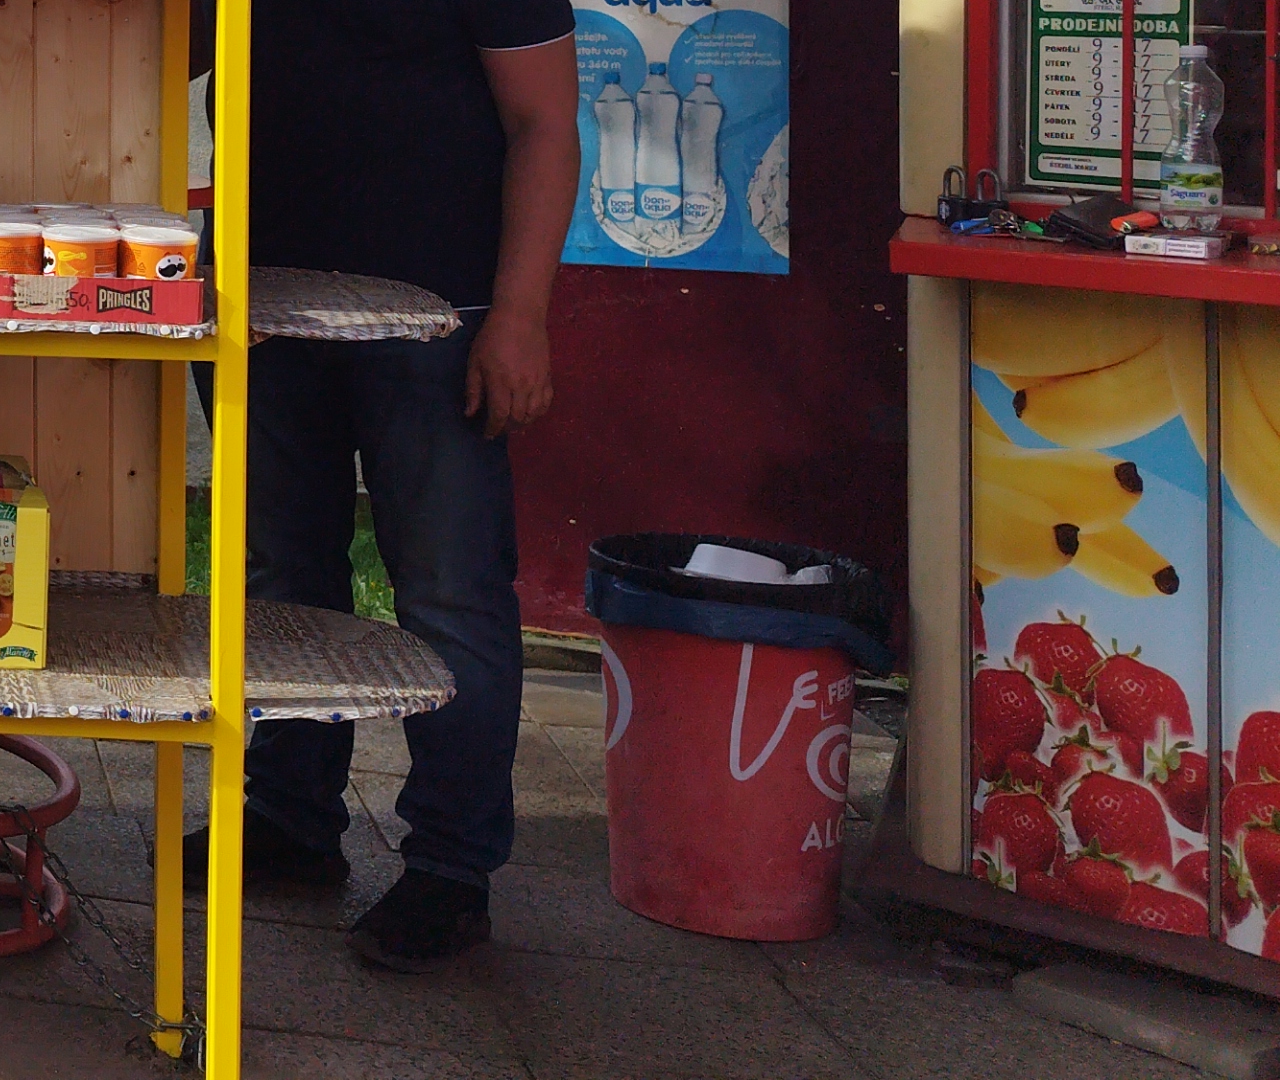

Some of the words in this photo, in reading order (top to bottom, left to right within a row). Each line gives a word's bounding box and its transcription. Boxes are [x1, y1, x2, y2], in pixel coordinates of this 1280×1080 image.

[1039, 16, 1124, 32] PRODEJNÍ
[1093, 38, 1102, 52] 9
[1093, 52, 1102, 67] 9
[1092, 67, 1101, 80] 9
[99, 288, 150, 311] PRINGLES
